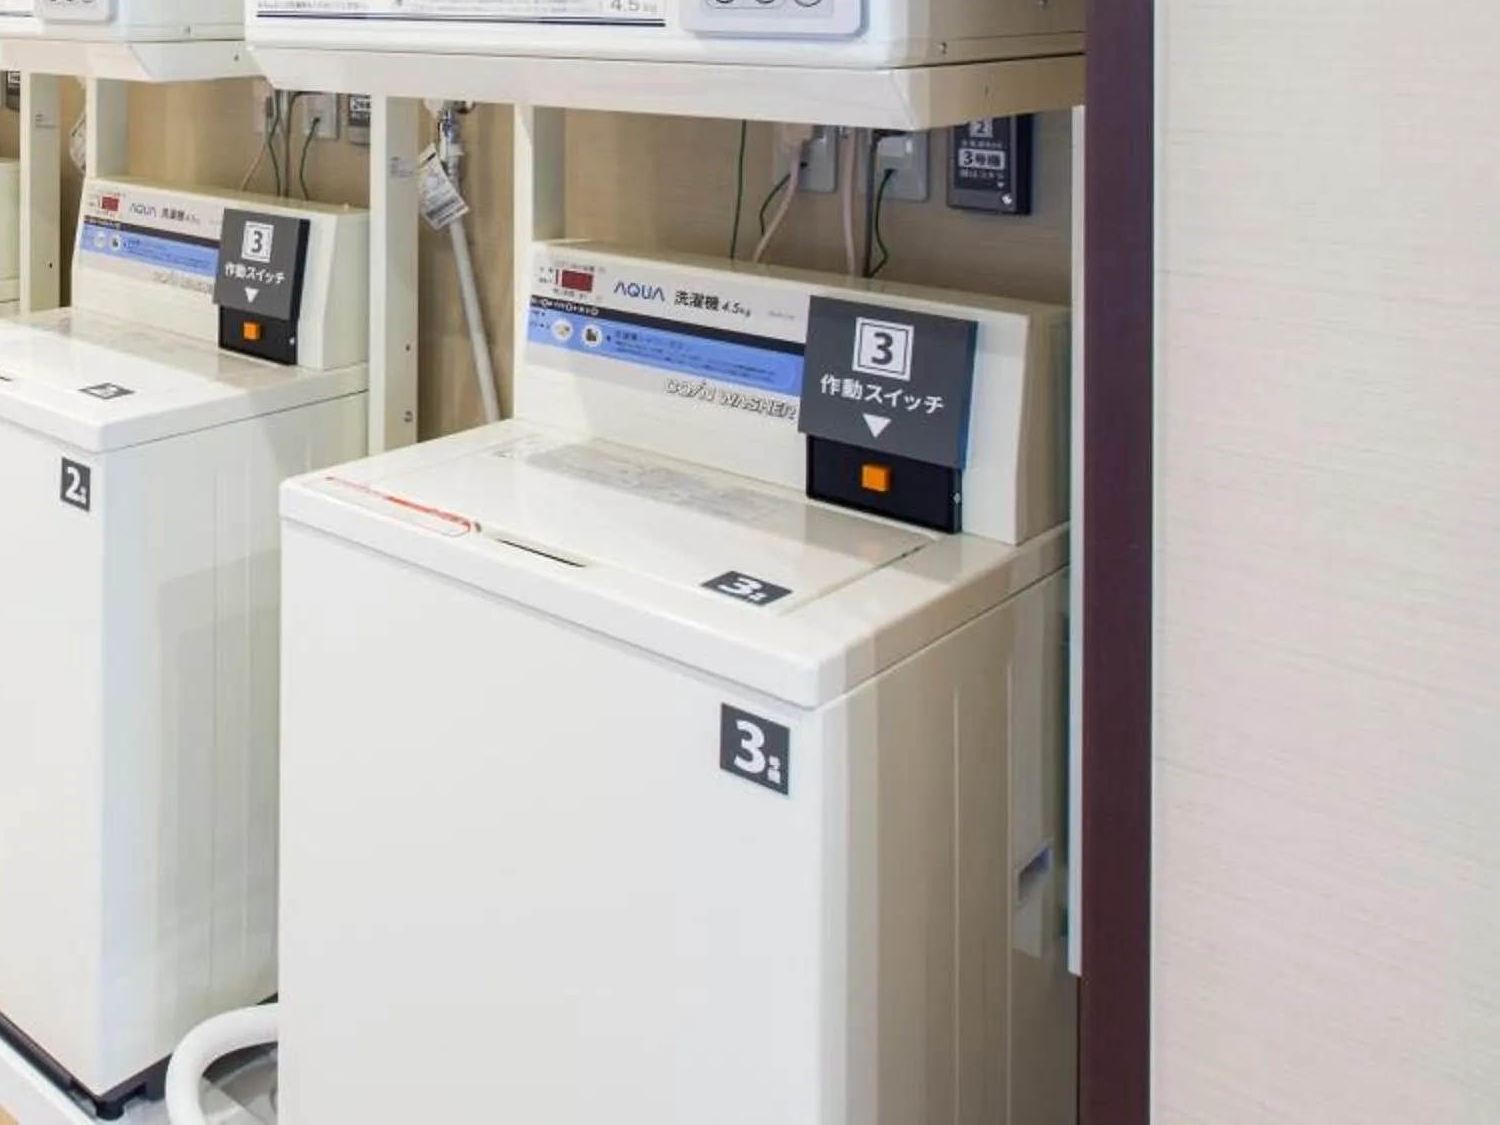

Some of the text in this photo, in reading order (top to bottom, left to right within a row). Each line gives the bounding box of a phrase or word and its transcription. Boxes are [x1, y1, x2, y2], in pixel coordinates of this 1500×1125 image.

[251, 230, 262, 253] 3
[225, 262, 285, 284] 作動スイッチ
[613, 281, 665, 303] AQUA
[674, 290, 719, 313] 洗濯機
[871, 332, 893, 365] 3
[820, 374, 944, 414] 作動スイッチ
